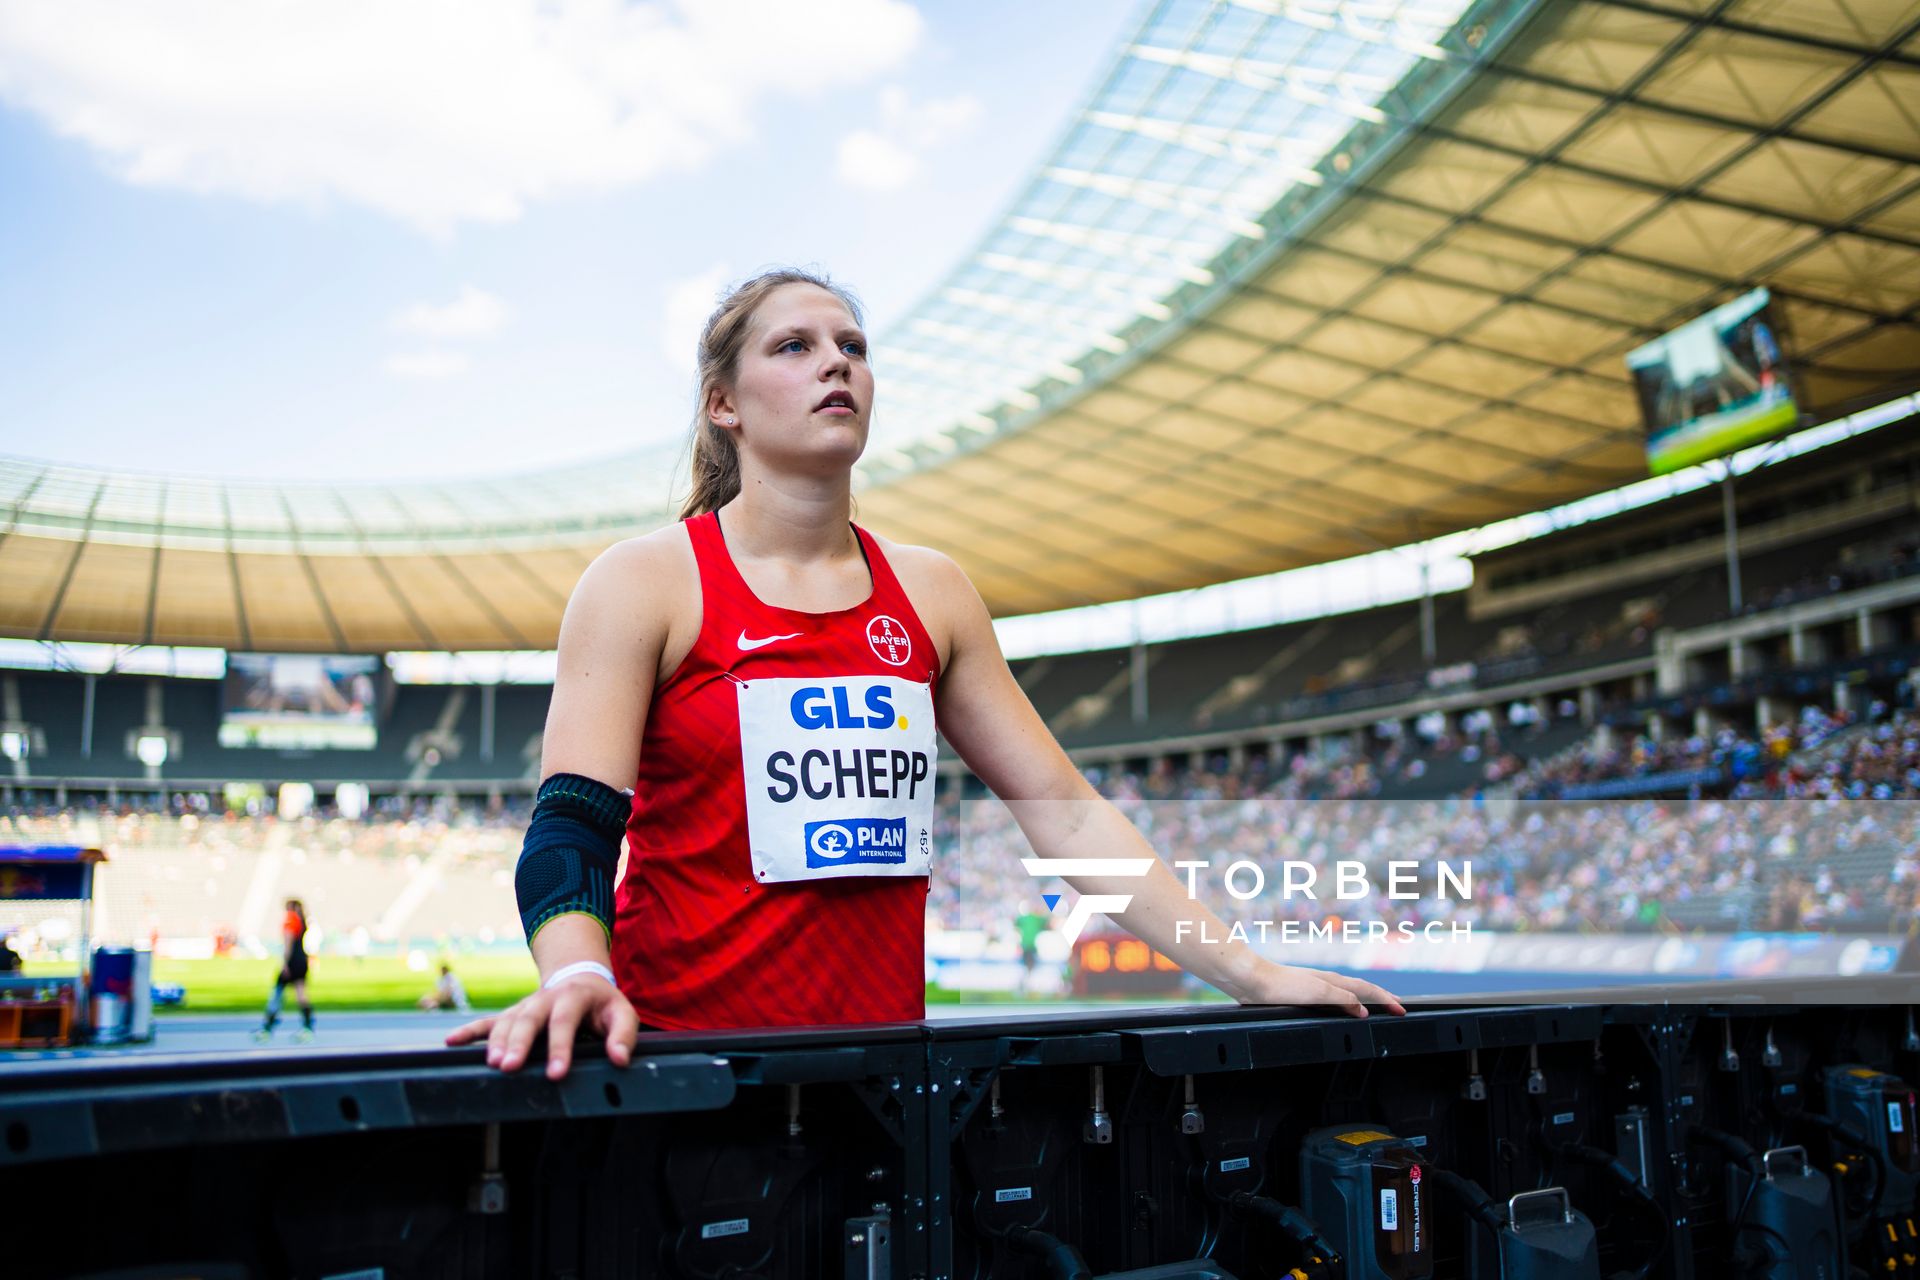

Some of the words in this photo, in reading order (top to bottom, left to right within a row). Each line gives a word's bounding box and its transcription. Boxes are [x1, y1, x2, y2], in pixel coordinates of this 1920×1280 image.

[871, 635, 908, 646] BAYER
[882, 619, 899, 662] BAYER
[766, 749, 928, 803] SCHEPP
[857, 827, 903, 847] PLAN
[919, 828, 928, 855] 452
